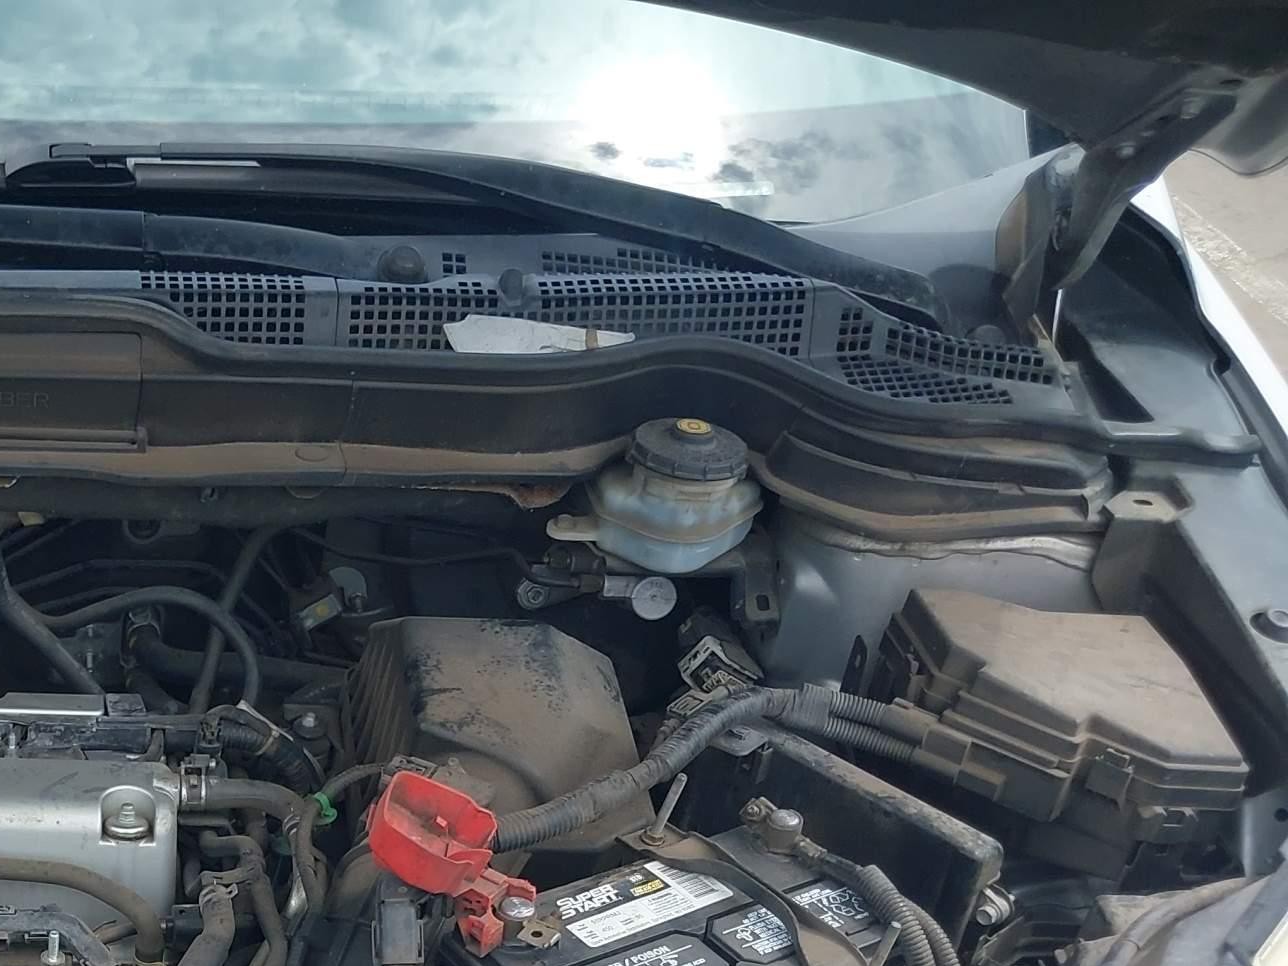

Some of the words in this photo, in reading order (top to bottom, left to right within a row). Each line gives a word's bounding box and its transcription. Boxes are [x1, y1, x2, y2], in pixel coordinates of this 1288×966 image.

[556, 884, 614, 911] SUPER
[560, 889, 619, 919] START
[631, 945, 671, 964] POISON
